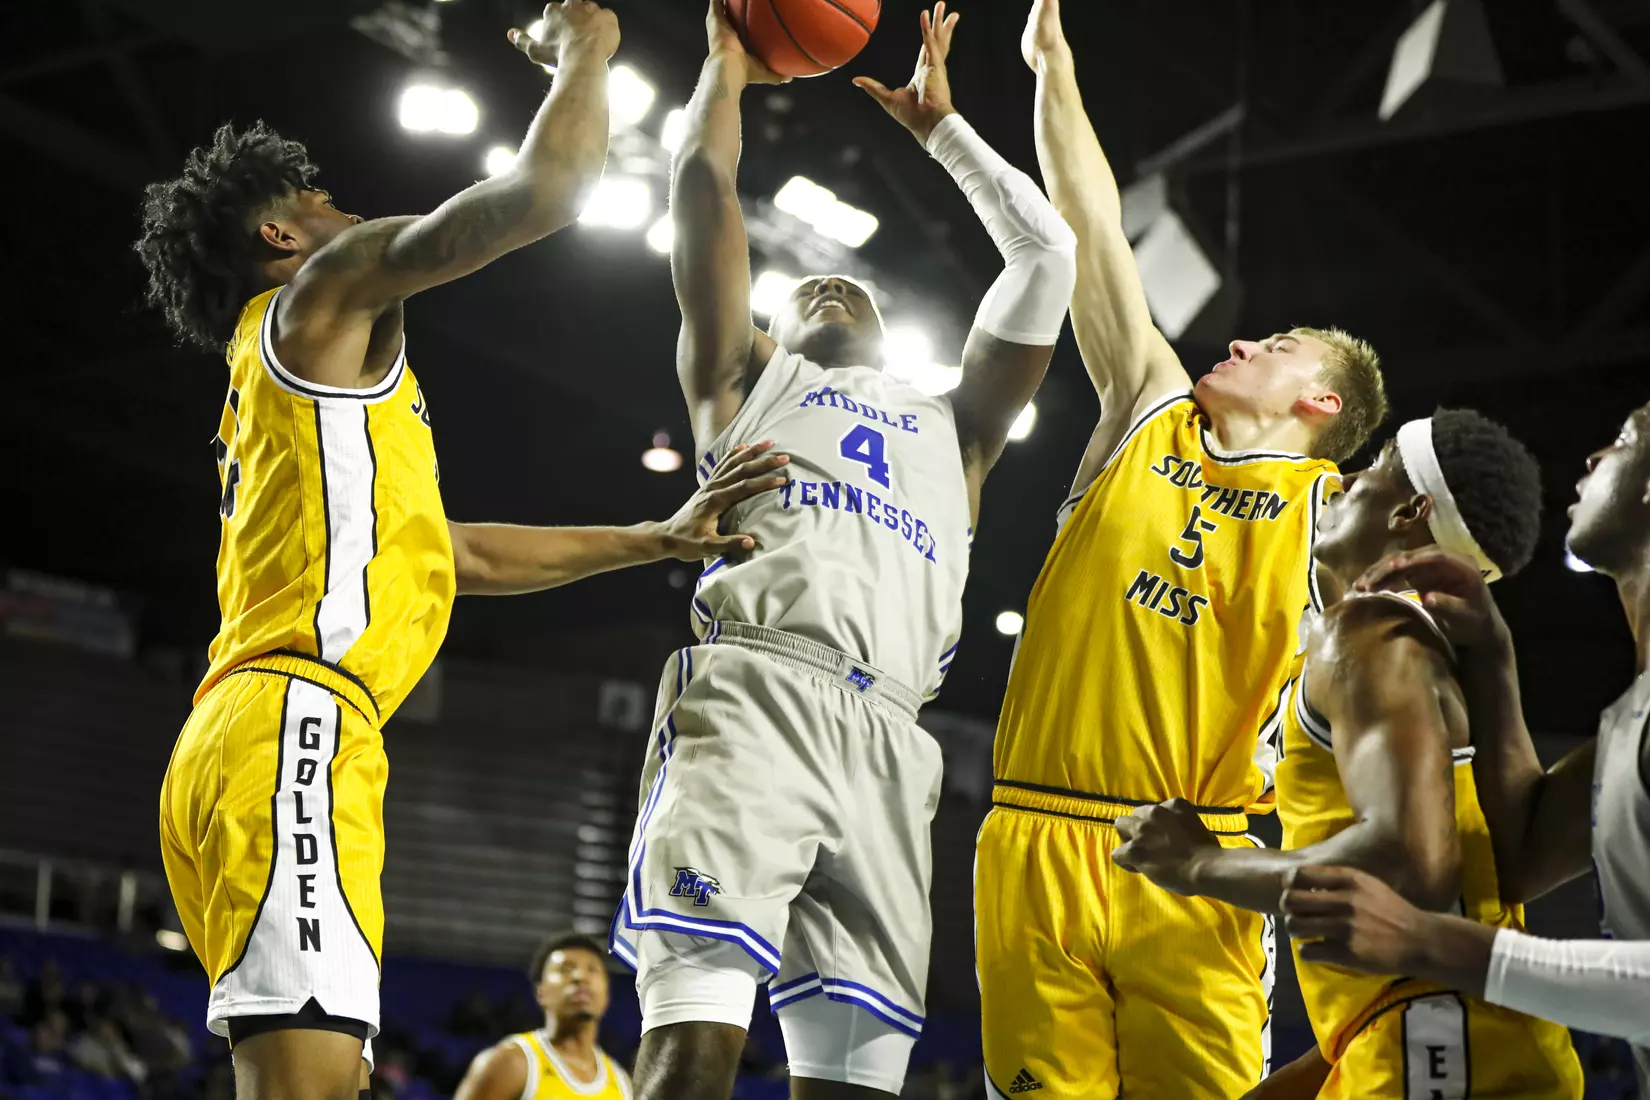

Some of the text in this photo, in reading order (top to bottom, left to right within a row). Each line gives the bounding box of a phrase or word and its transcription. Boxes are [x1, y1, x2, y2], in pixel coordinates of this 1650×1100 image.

[799, 386, 919, 434] MIDDLE
[838, 422, 891, 491] 4
[1151, 455, 1288, 521] SOUTHERN
[1169, 506, 1218, 569] 5
[1125, 570, 1208, 626] MISS
[292, 716, 322, 953] GOLDEN
[668, 867, 717, 907] MT
[1009, 1081, 1043, 1094] adidas
[1424, 1045, 1449, 1100] E
